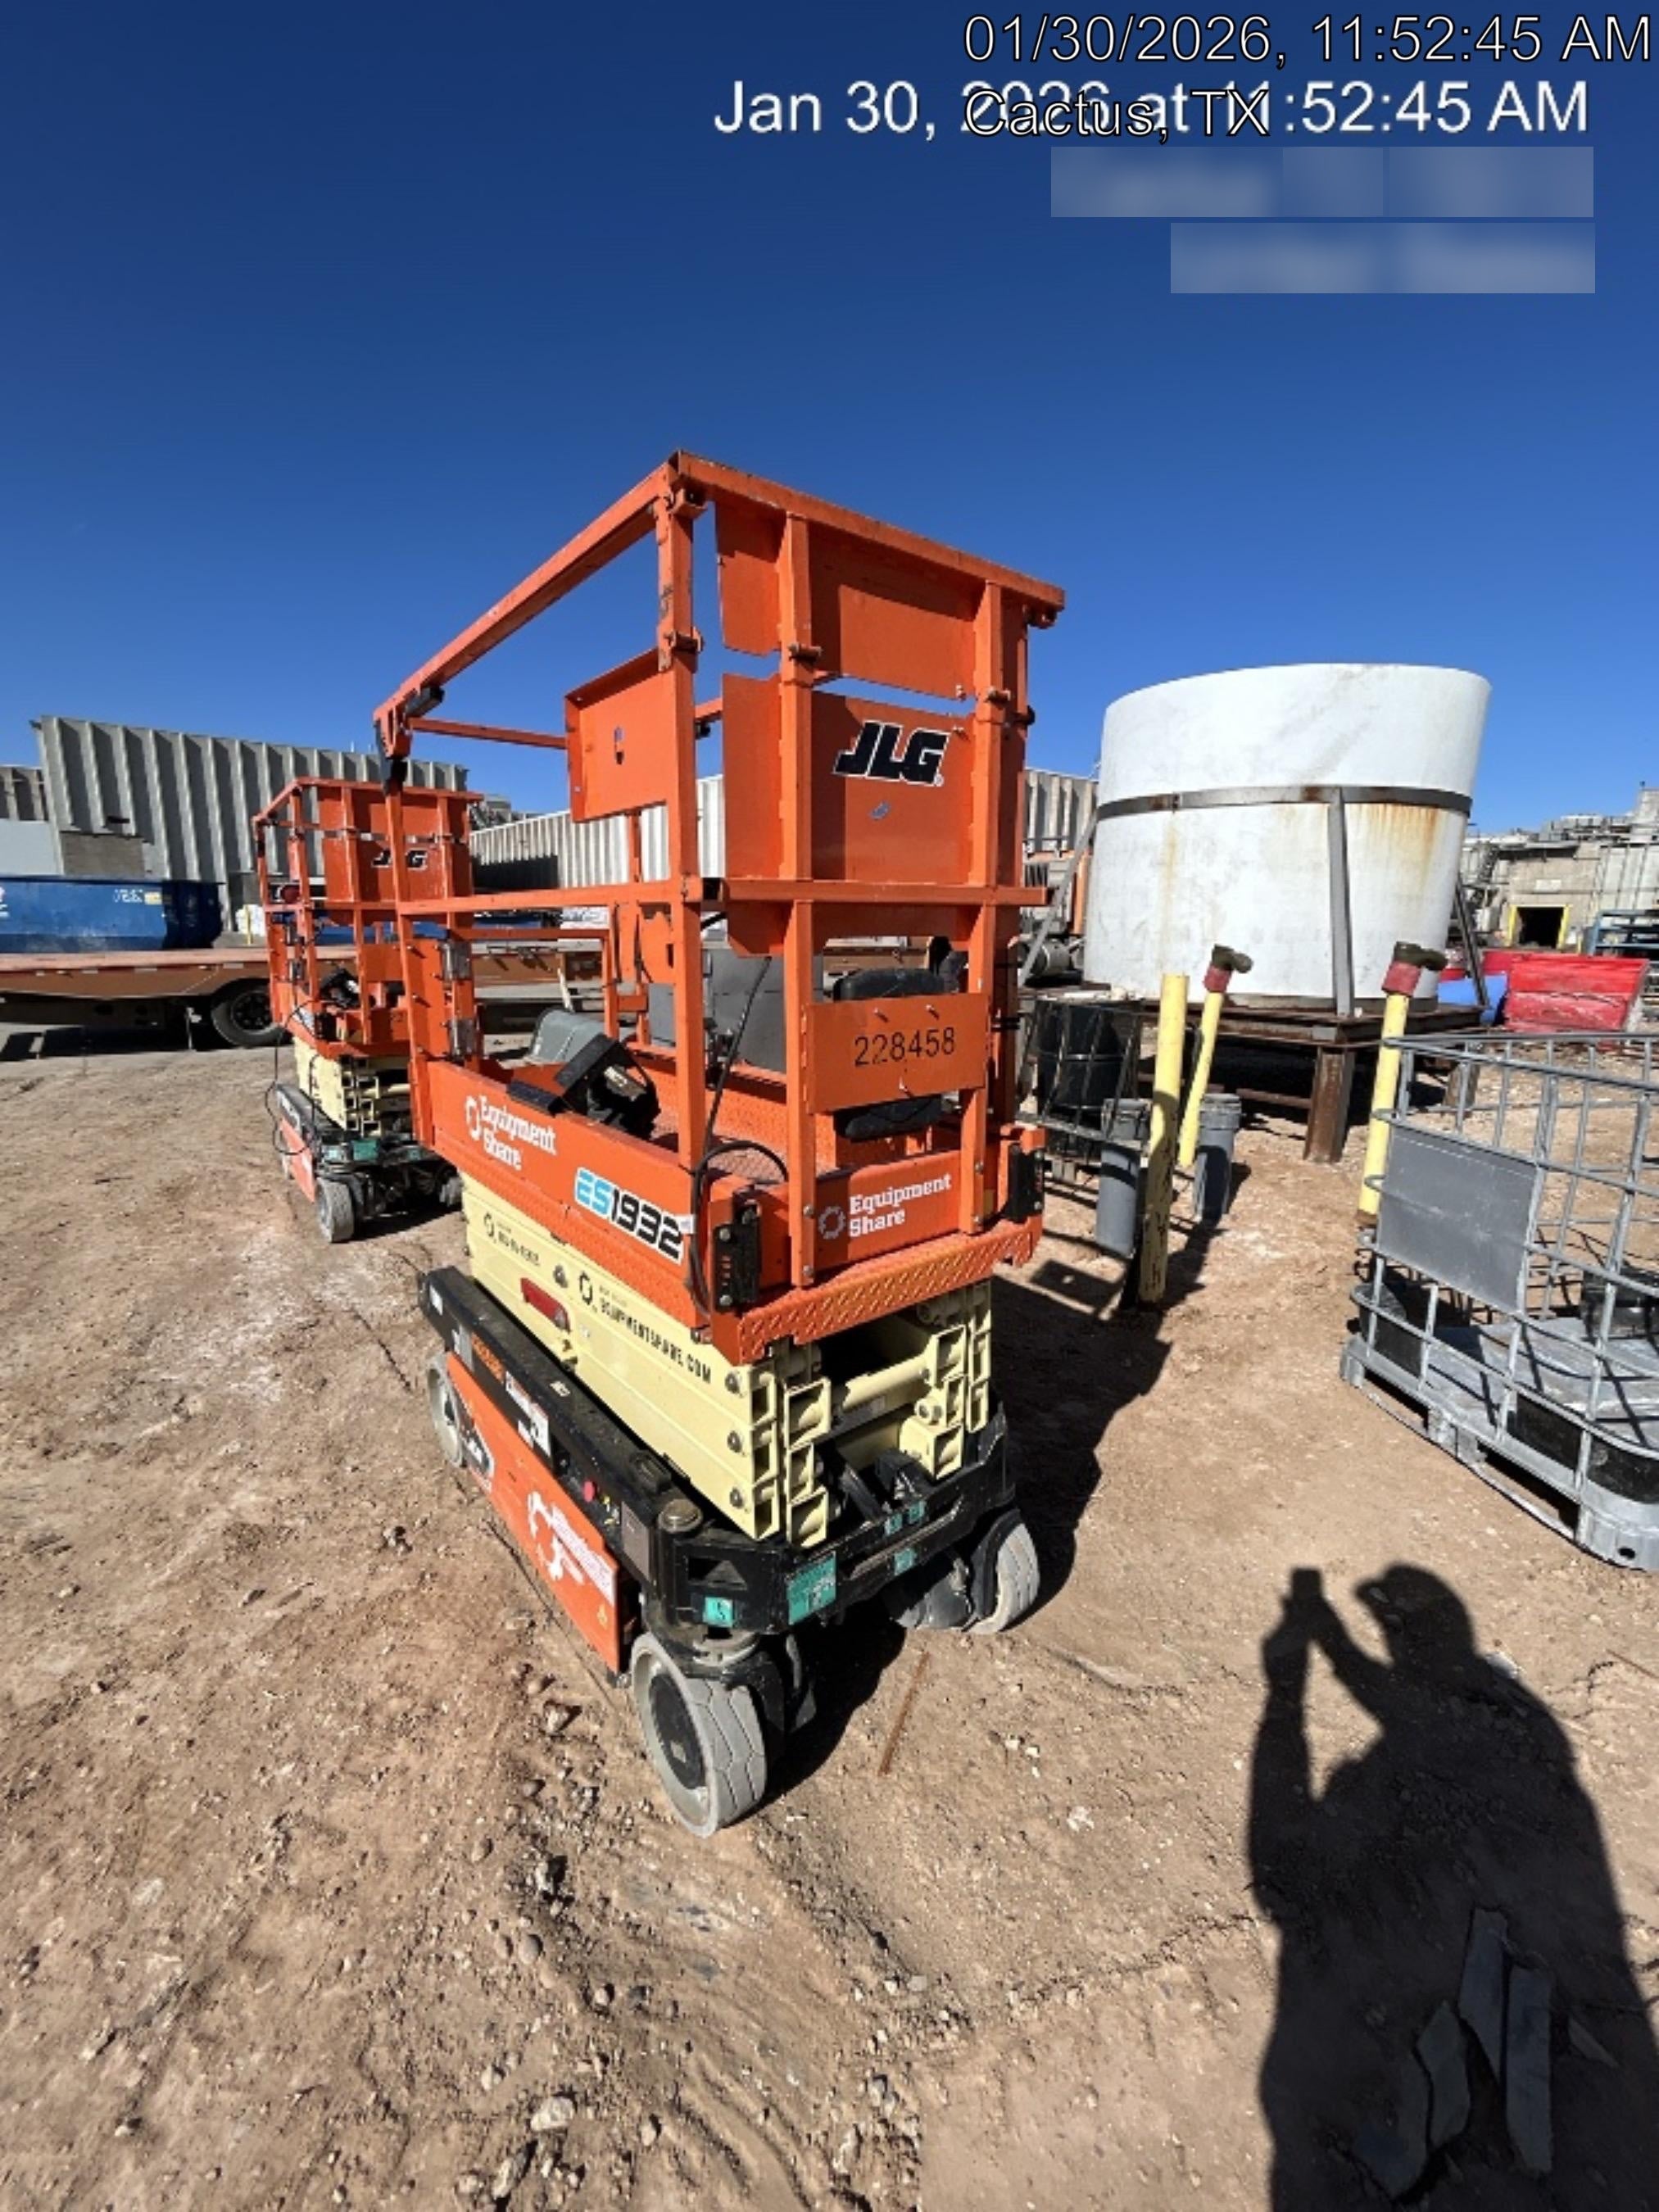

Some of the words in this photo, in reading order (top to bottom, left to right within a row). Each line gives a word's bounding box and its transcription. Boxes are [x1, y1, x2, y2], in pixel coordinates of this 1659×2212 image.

[832, 719, 952, 786] JLG
[371, 847, 428, 870] JG
[854, 1027, 955, 1067] 228458
[480, 1095, 557, 1156] Equipment
[483, 1128, 523, 1172] Share
[849, 1172, 953, 1215] Equipment
[575, 1167, 684, 1265] ES1932
[849, 1208, 906, 1238] Share
